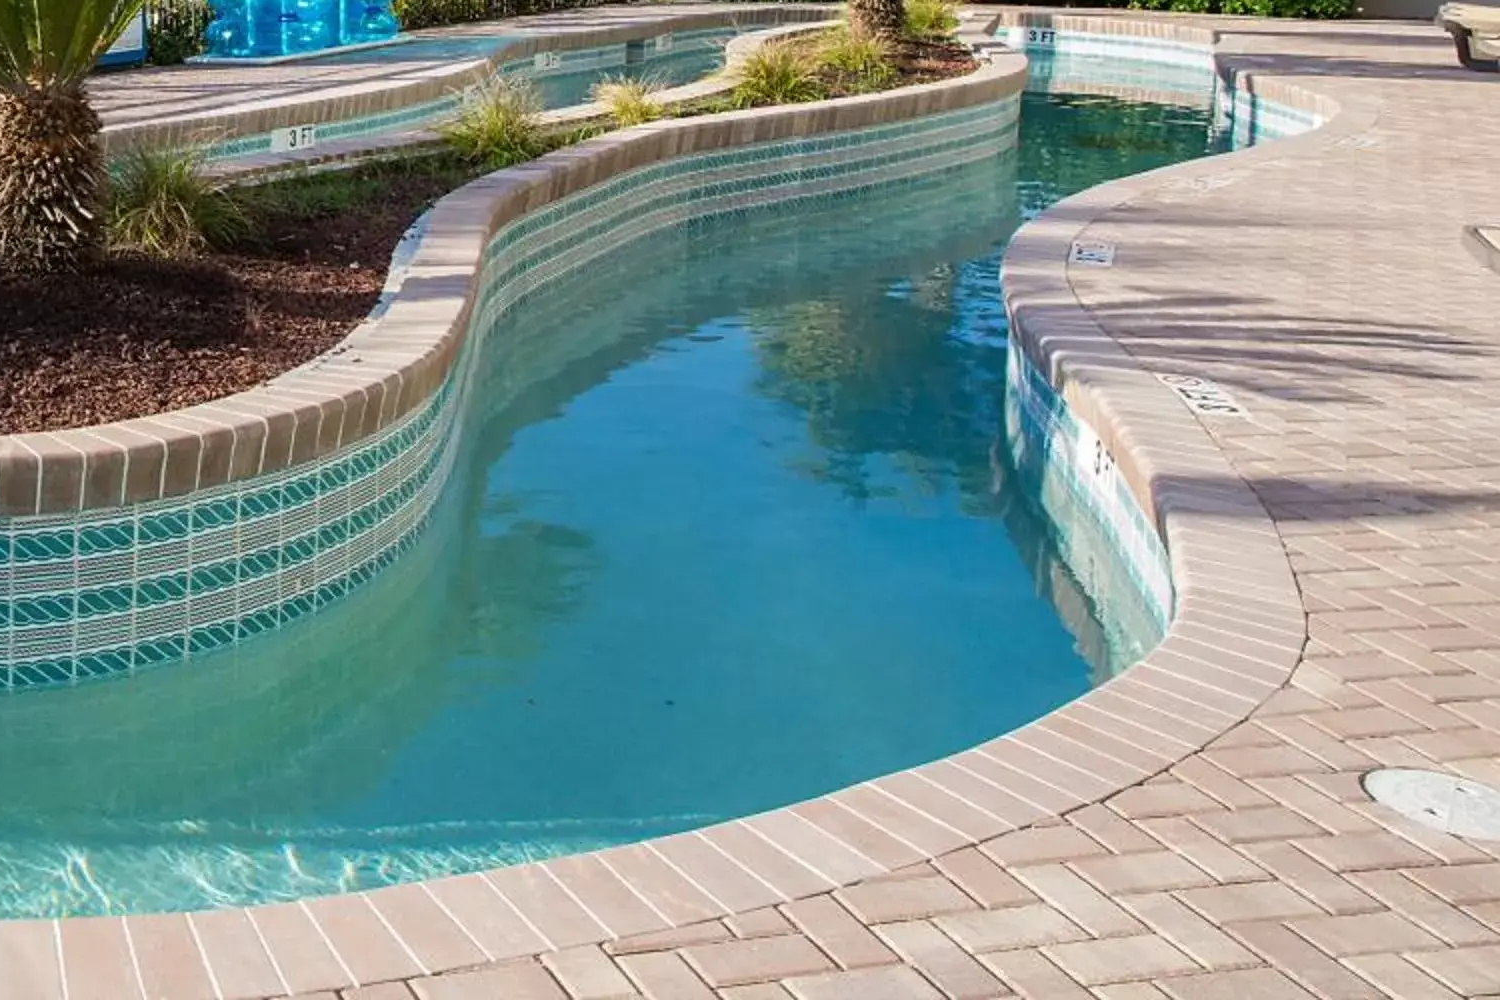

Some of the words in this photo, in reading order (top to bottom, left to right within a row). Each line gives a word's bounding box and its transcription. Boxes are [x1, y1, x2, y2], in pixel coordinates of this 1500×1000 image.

[1029, 29, 1037, 42] 3
[1041, 31, 1057, 43] FT
[289, 129, 297, 148] 3
[302, 127, 313, 145] FT
